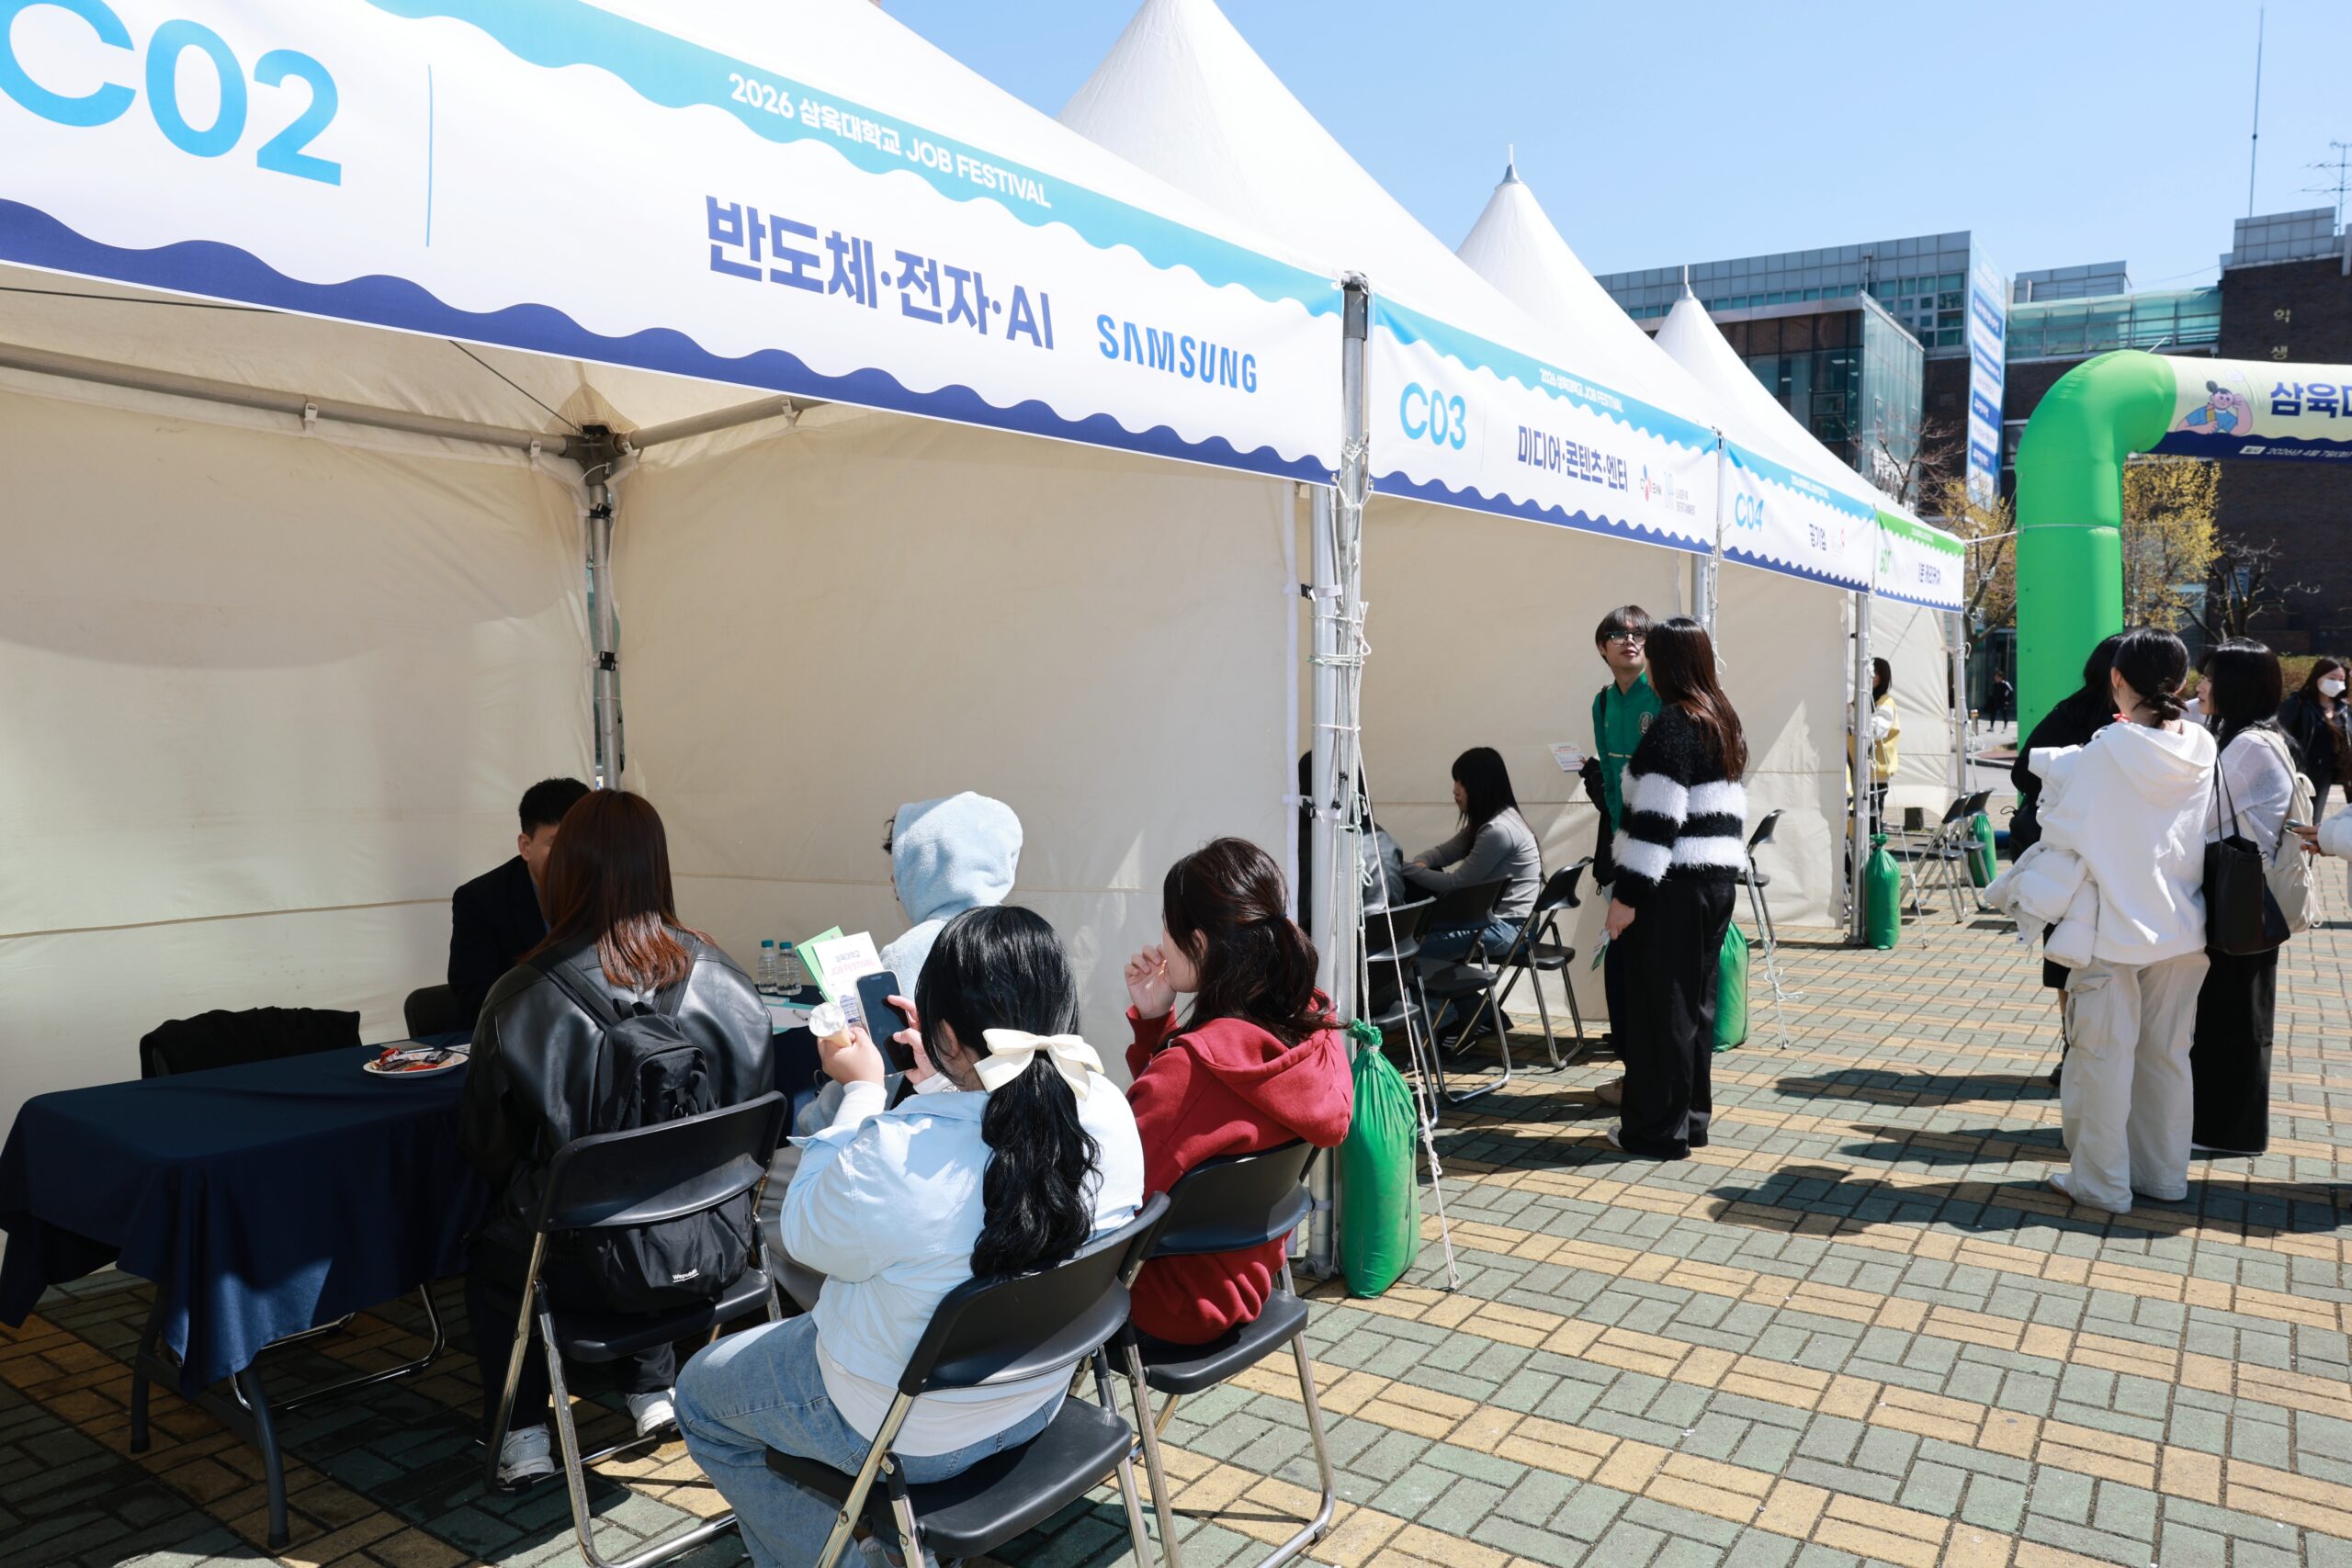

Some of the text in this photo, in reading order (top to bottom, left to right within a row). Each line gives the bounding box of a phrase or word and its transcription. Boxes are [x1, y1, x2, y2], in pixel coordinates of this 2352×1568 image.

[0, 0, 342, 186] C02
[729, 73, 1052, 209] 2026 삼육대학교 JOB FESTIVAL
[706, 195, 1054, 351] 반도체·전자·AI
[1096, 313, 1258, 394] SAMSUNG
[1399, 382, 1467, 450] C03
[1518, 424, 1628, 492] 미디어·콘텐츠·엔터
[1735, 491, 1764, 533] C04
